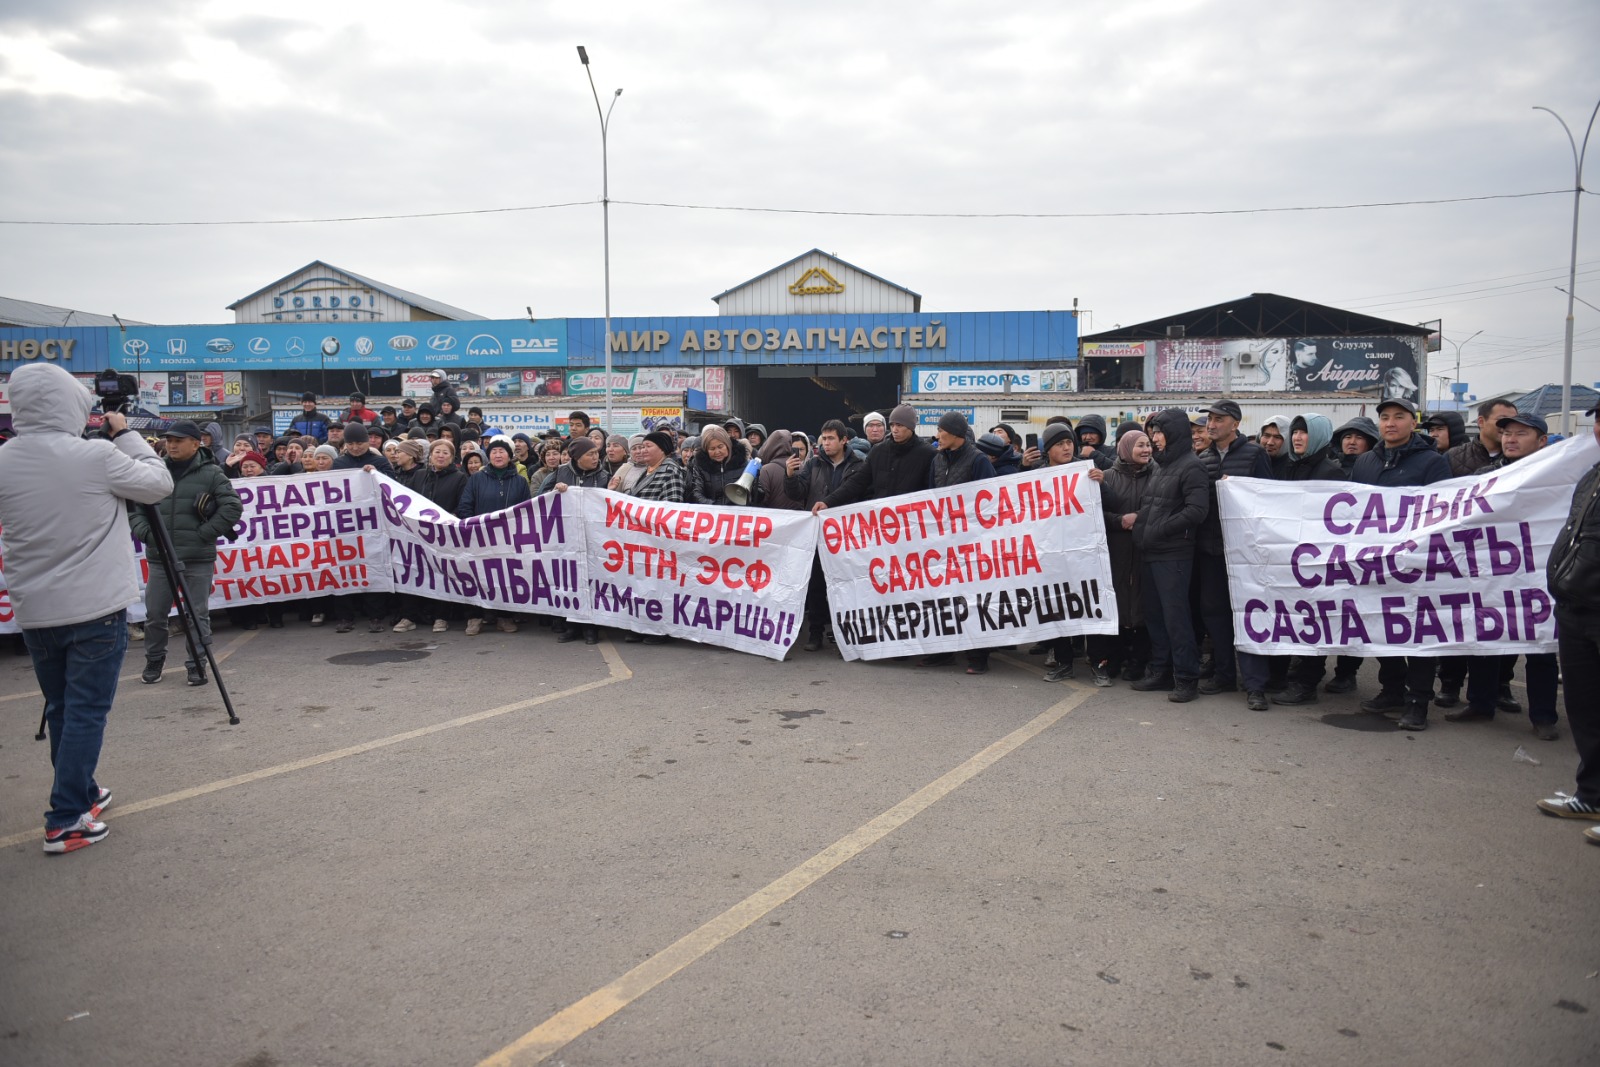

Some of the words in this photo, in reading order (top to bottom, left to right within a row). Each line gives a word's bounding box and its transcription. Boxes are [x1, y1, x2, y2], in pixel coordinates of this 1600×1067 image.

[273, 294, 374, 308] DORDOI
[511, 338, 558, 348] DAF
[609, 331, 670, 351] МИР
[680, 320, 947, 351] АВТОЗАПЧАСТЕЙ
[1332, 340, 1374, 350] Сулуулук
[1365, 351, 1395, 360] салону
[224, 382, 241, 395] 85
[583, 372, 630, 388] Casrol
[671, 378, 703, 388] FELIX
[706, 368, 725, 384] 29
[1306, 358, 1380, 390] Айдай
[642, 408, 680, 416] ТУРБИНАЛАР
[235, 479, 352, 514] РДАГЫ
[1323, 476, 1499, 535] САЛЫК
[605, 497, 772, 548] ИШКЕРЛЕР
[822, 495, 968, 554] ӨКМӨТТҮН
[974, 473, 1085, 529] САЛЫК
[602, 540, 686, 587] ЭТТН,
[695, 555, 771, 592] ЭСФ
[869, 534, 1042, 595] САЯСАТЫНА
[1290, 522, 1536, 588] САЯСАТЫ
[589, 579, 663, 621] КМге
[673, 593, 795, 647] КАРШЫ!
[836, 596, 969, 645] ИШКЕРЛЕР
[976, 578, 1103, 631] КАРШЫ!
[1244, 598, 1372, 645] САЗГА
[1380, 587, 1558, 644] БАТЫР
